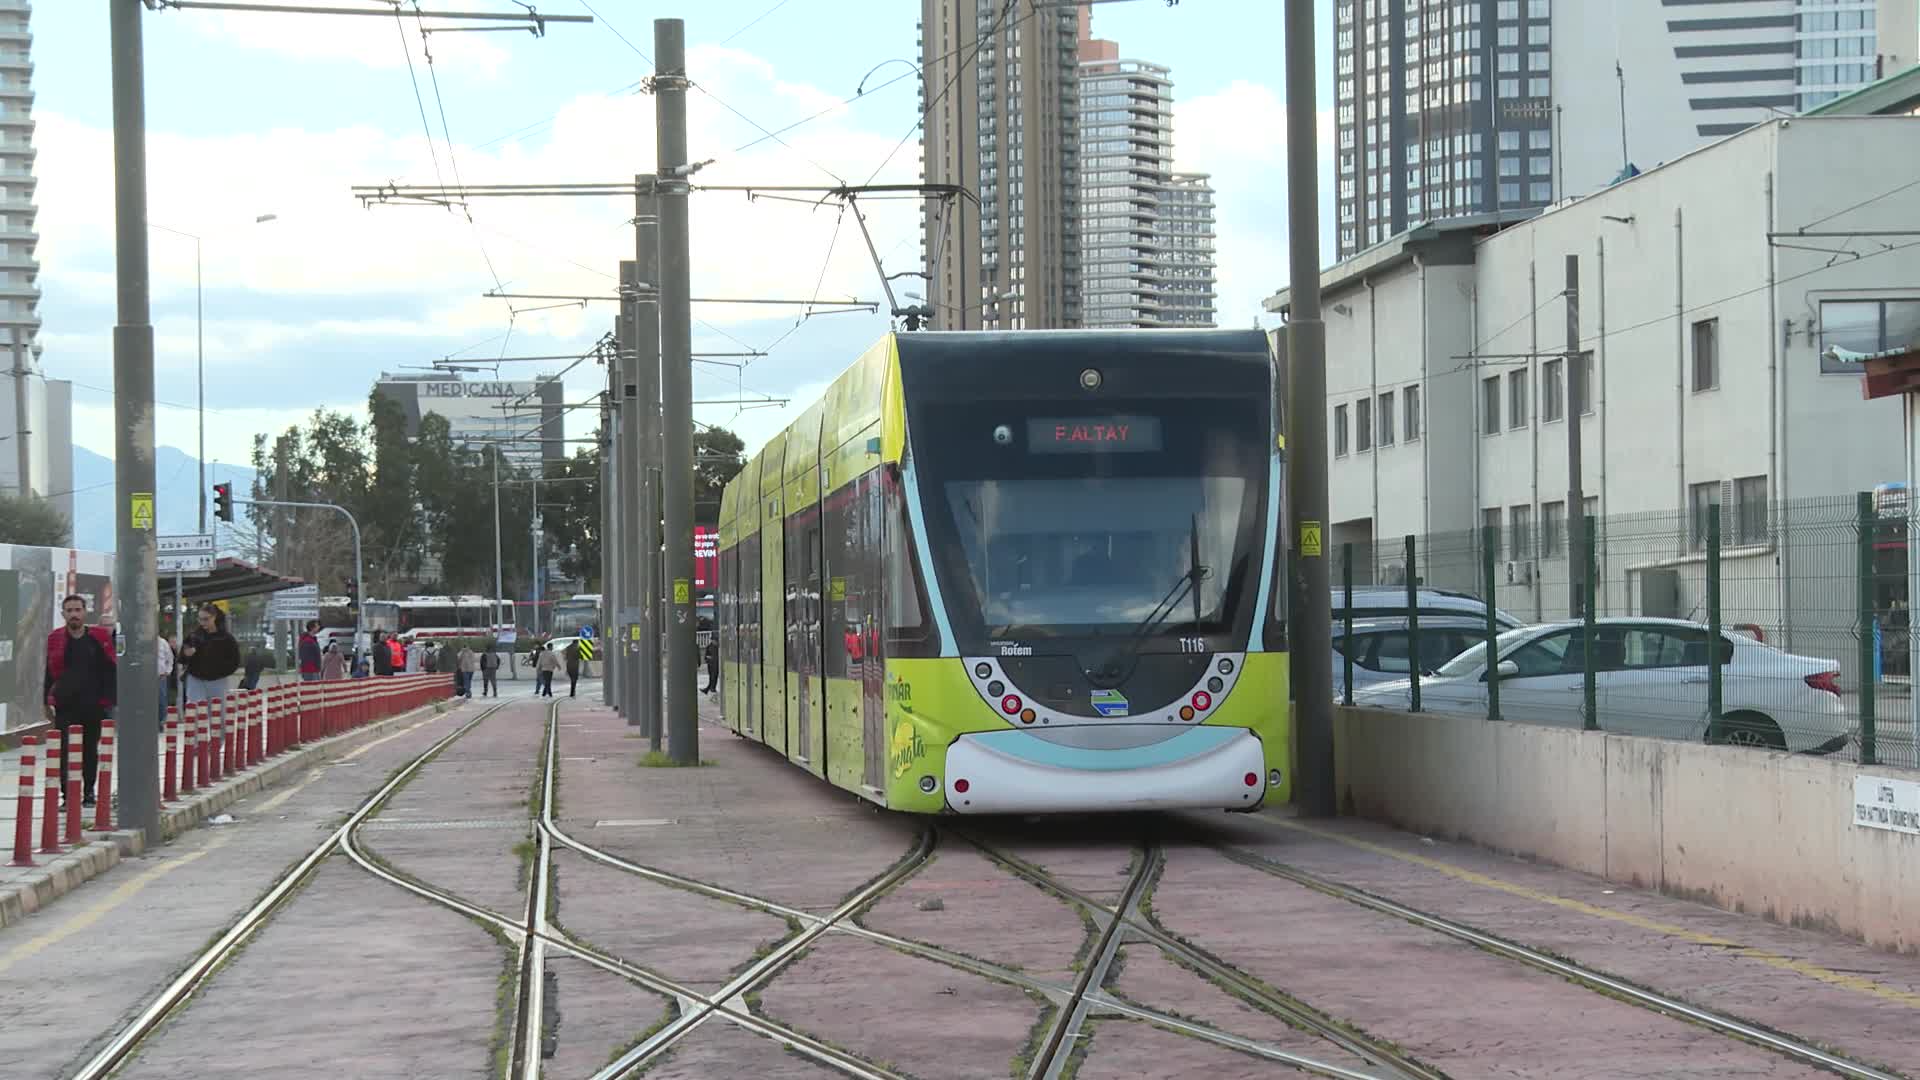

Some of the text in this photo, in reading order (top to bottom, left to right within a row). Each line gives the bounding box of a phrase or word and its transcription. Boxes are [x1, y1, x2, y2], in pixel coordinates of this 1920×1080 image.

[426, 382, 514, 396] MEDICANA
[1055, 424, 1129, 441] F.ALTAY
[1001, 642, 1032, 656] Rotem
[1179, 637, 1205, 653] T116
